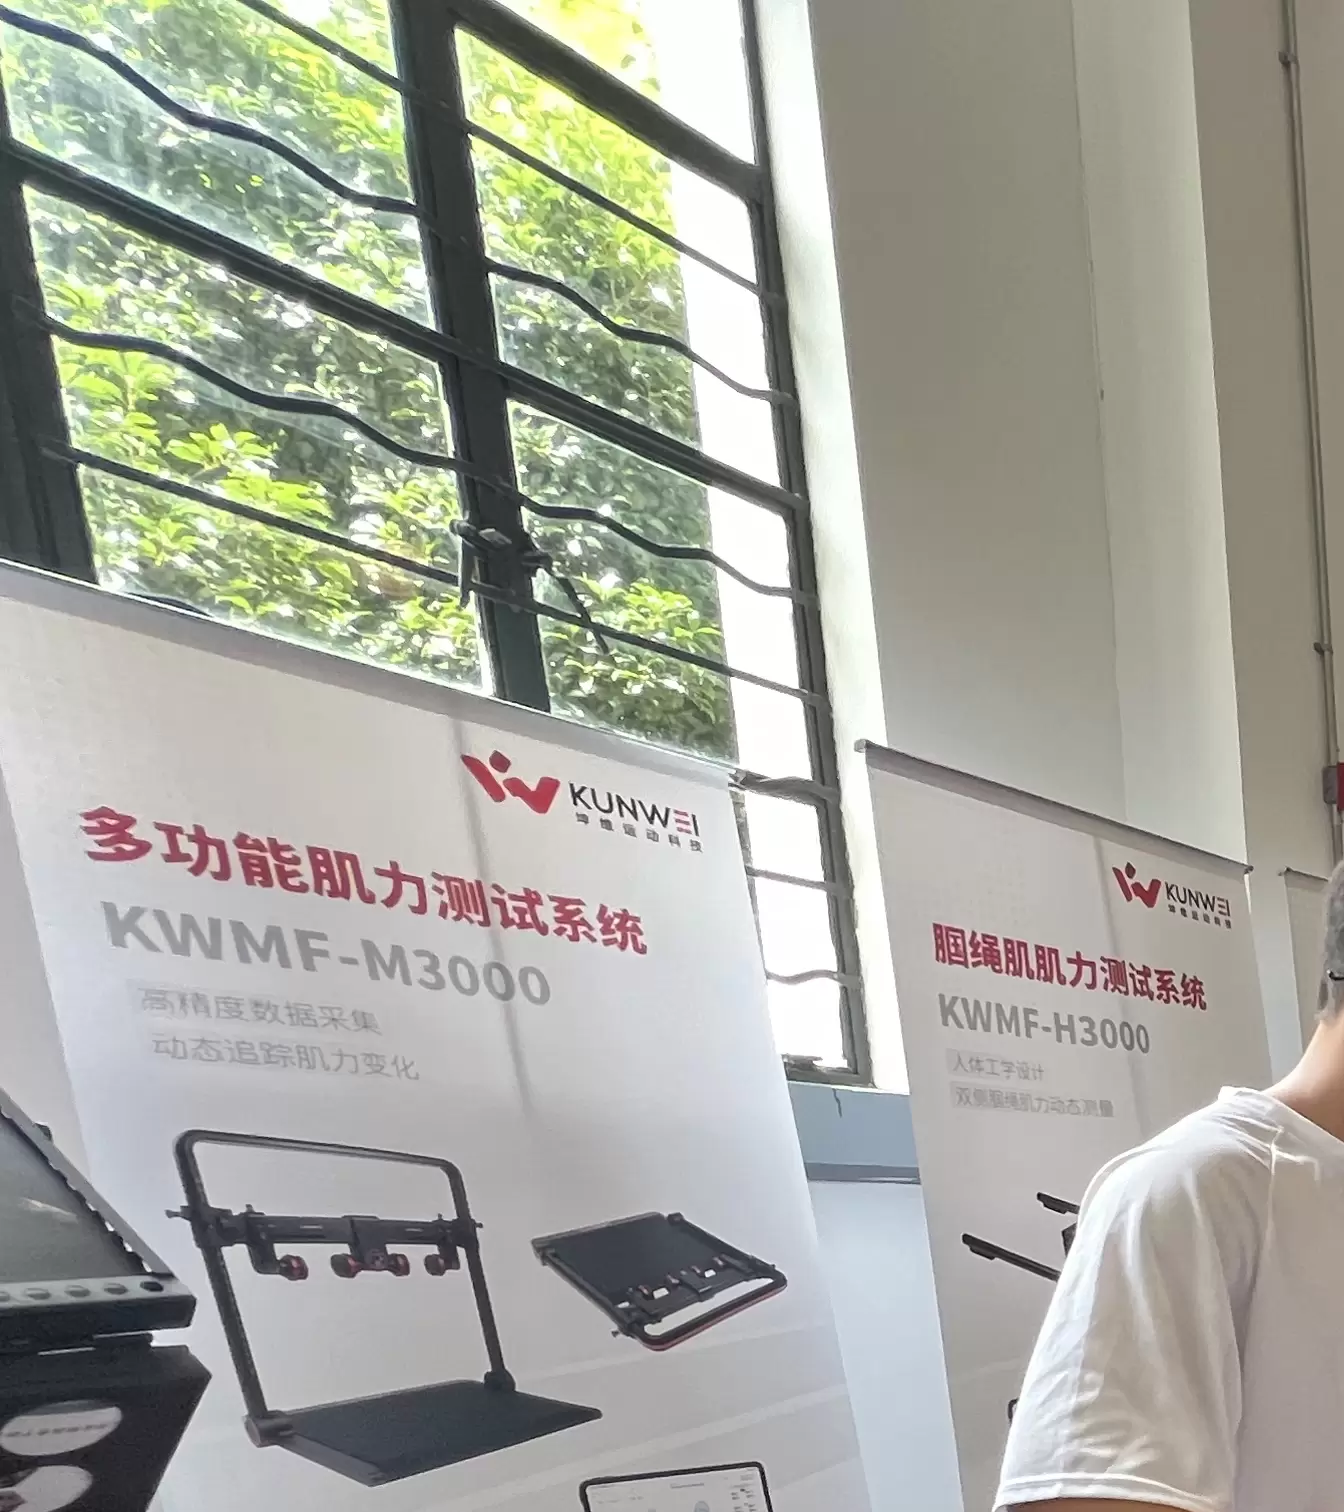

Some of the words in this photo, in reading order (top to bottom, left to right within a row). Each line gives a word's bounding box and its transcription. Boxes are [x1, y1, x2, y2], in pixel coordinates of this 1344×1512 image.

[569, 782, 701, 837] KUNWEI
[81, 804, 648, 956] 多功能肌力测试系统
[1164, 881, 1231, 917] KUNWEI
[102, 901, 552, 1006] KWMF-M3000
[932, 922, 1208, 1011] 腘绳肌肌力测试系统
[139, 987, 383, 1036] 高精度数据采集
[938, 993, 1151, 1054] KWMF-H3000
[152, 1032, 420, 1081] 动态追踪肌力变化
